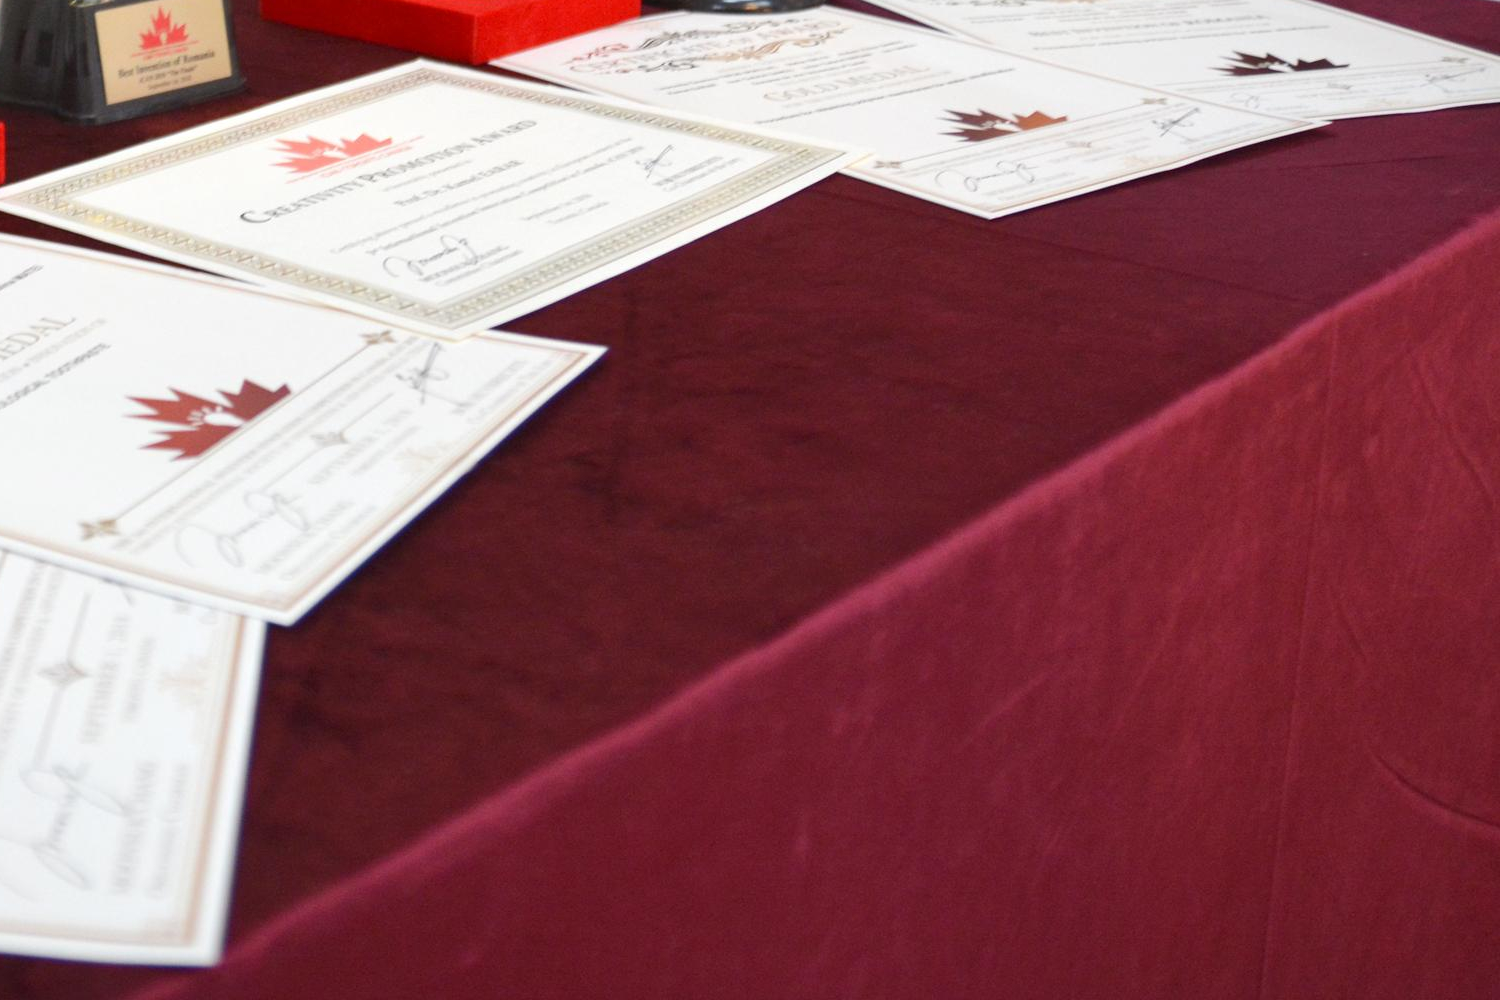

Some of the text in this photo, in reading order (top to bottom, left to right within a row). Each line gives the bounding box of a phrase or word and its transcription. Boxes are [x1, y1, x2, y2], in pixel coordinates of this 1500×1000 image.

[240, 178, 364, 223] CREATIVITY
[358, 142, 476, 182] PROMOTION
[470, 119, 538, 144] AWARD
